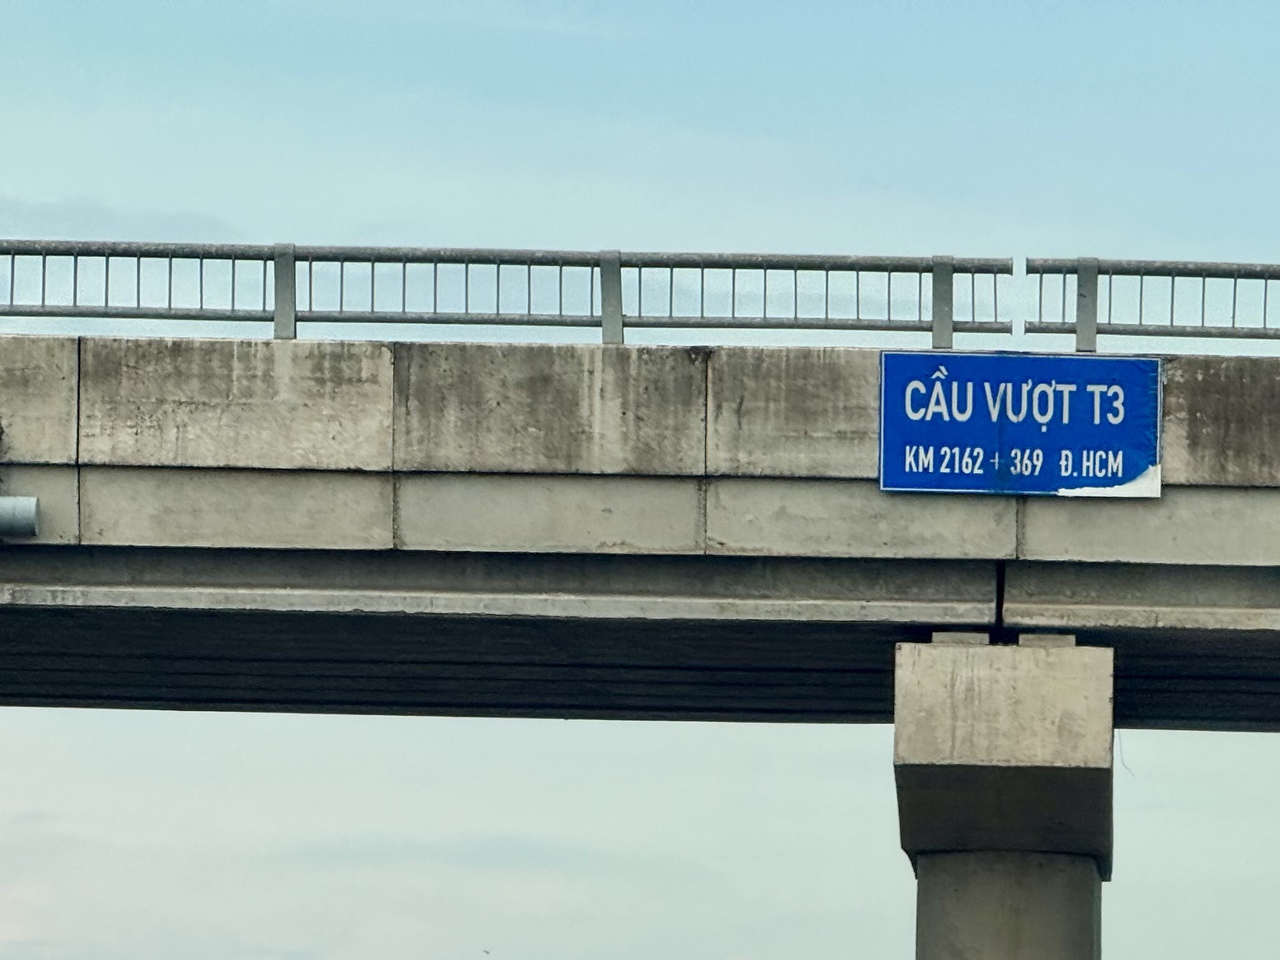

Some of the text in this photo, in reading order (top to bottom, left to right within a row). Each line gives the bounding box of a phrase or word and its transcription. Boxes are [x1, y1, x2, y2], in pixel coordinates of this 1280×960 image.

[905, 365, 1125, 432] CẦU VƯỢT T3
[905, 446, 934, 473] KM
[940, 446, 984, 474] 2162
[1010, 449, 1043, 476] 369
